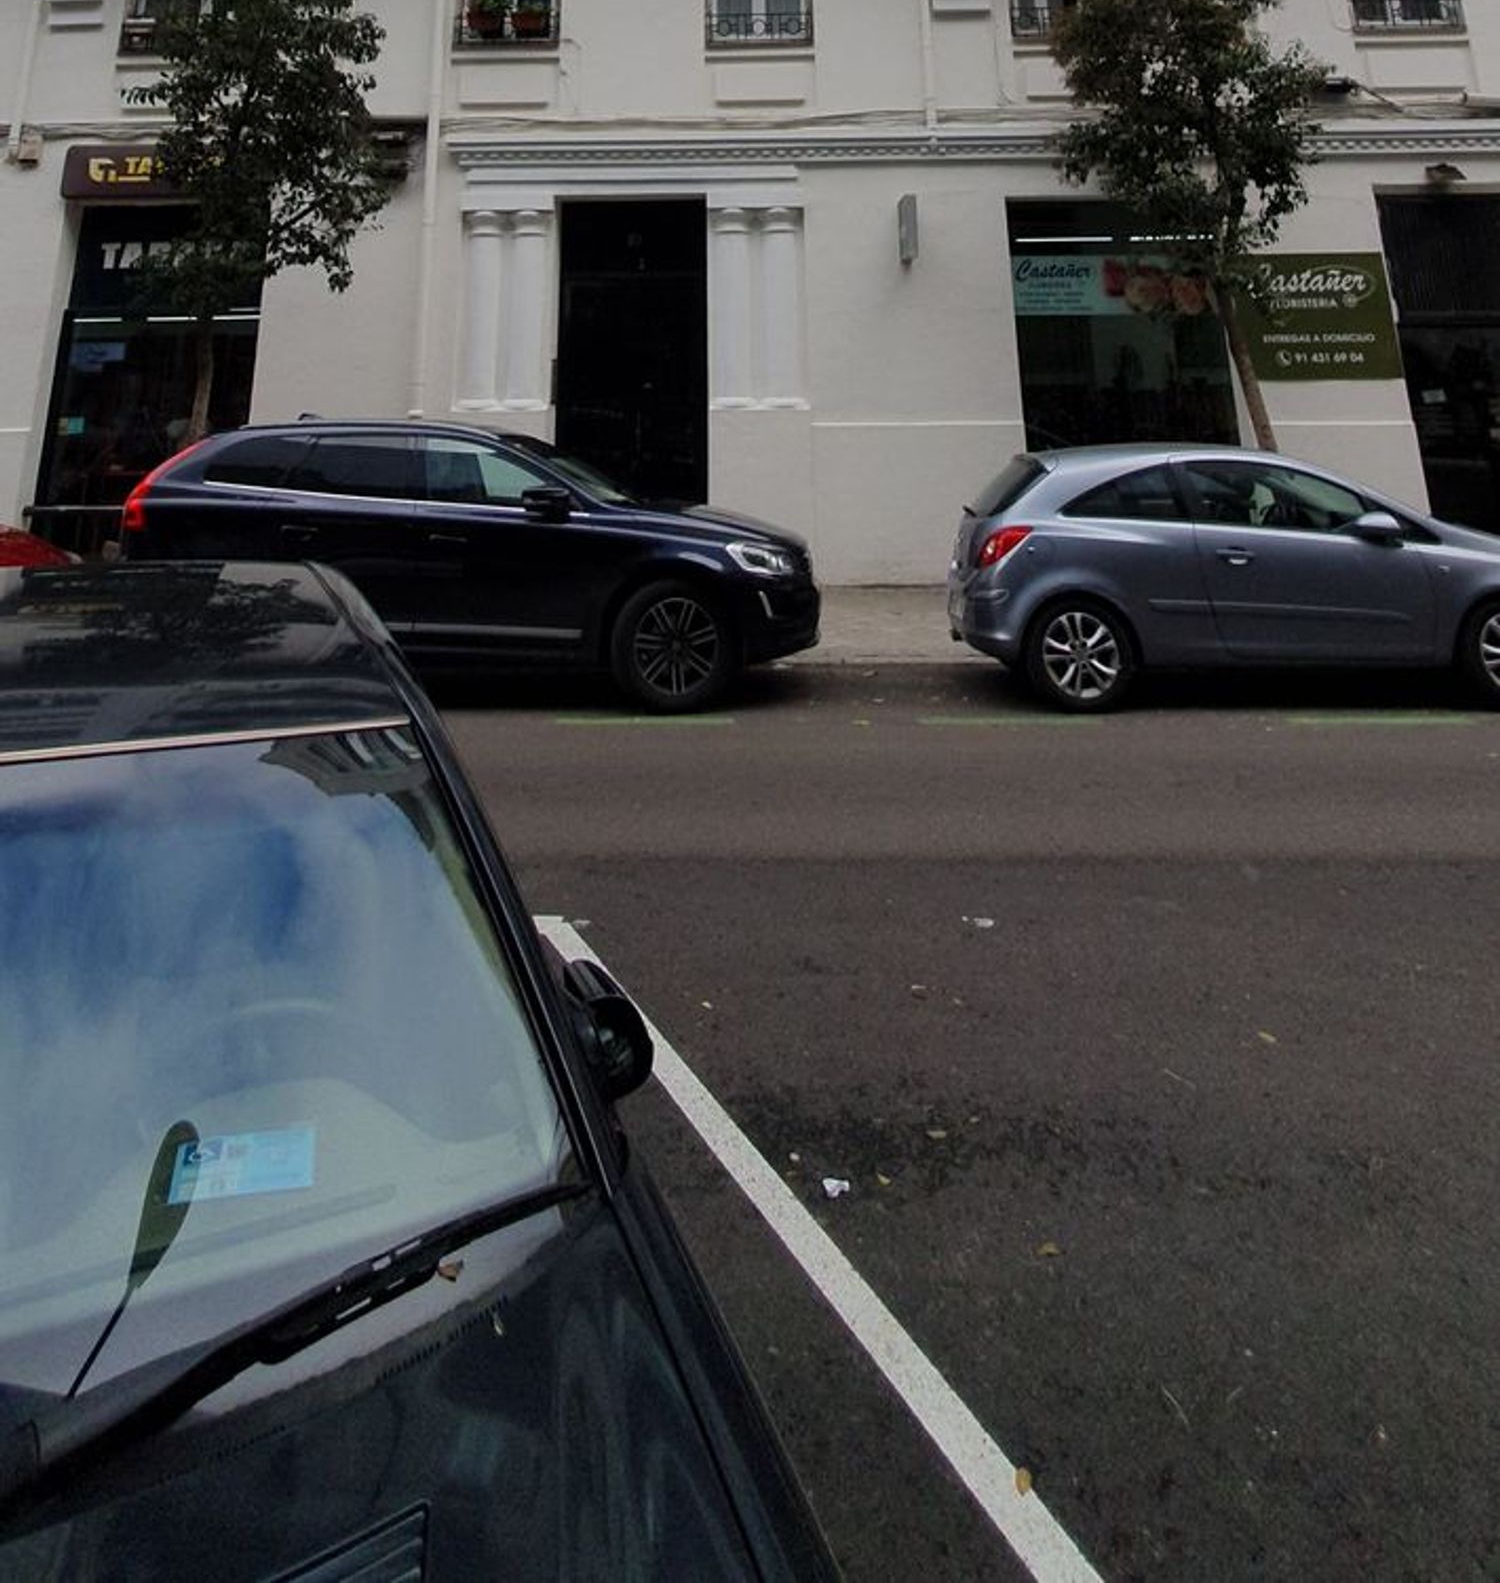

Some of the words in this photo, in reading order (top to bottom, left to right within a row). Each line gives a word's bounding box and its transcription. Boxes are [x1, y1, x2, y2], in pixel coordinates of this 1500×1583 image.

[1015, 258, 1092, 283] Castañer
[1263, 333, 1312, 344] ENTREGAS
[1313, 333, 1321, 344] A
[1322, 333, 1376, 343] DOMICILIO
[1294, 351, 1307, 363] 91
[1311, 351, 1330, 363] 431
[1333, 351, 1348, 363] 69
[1350, 351, 1365, 363] 04
